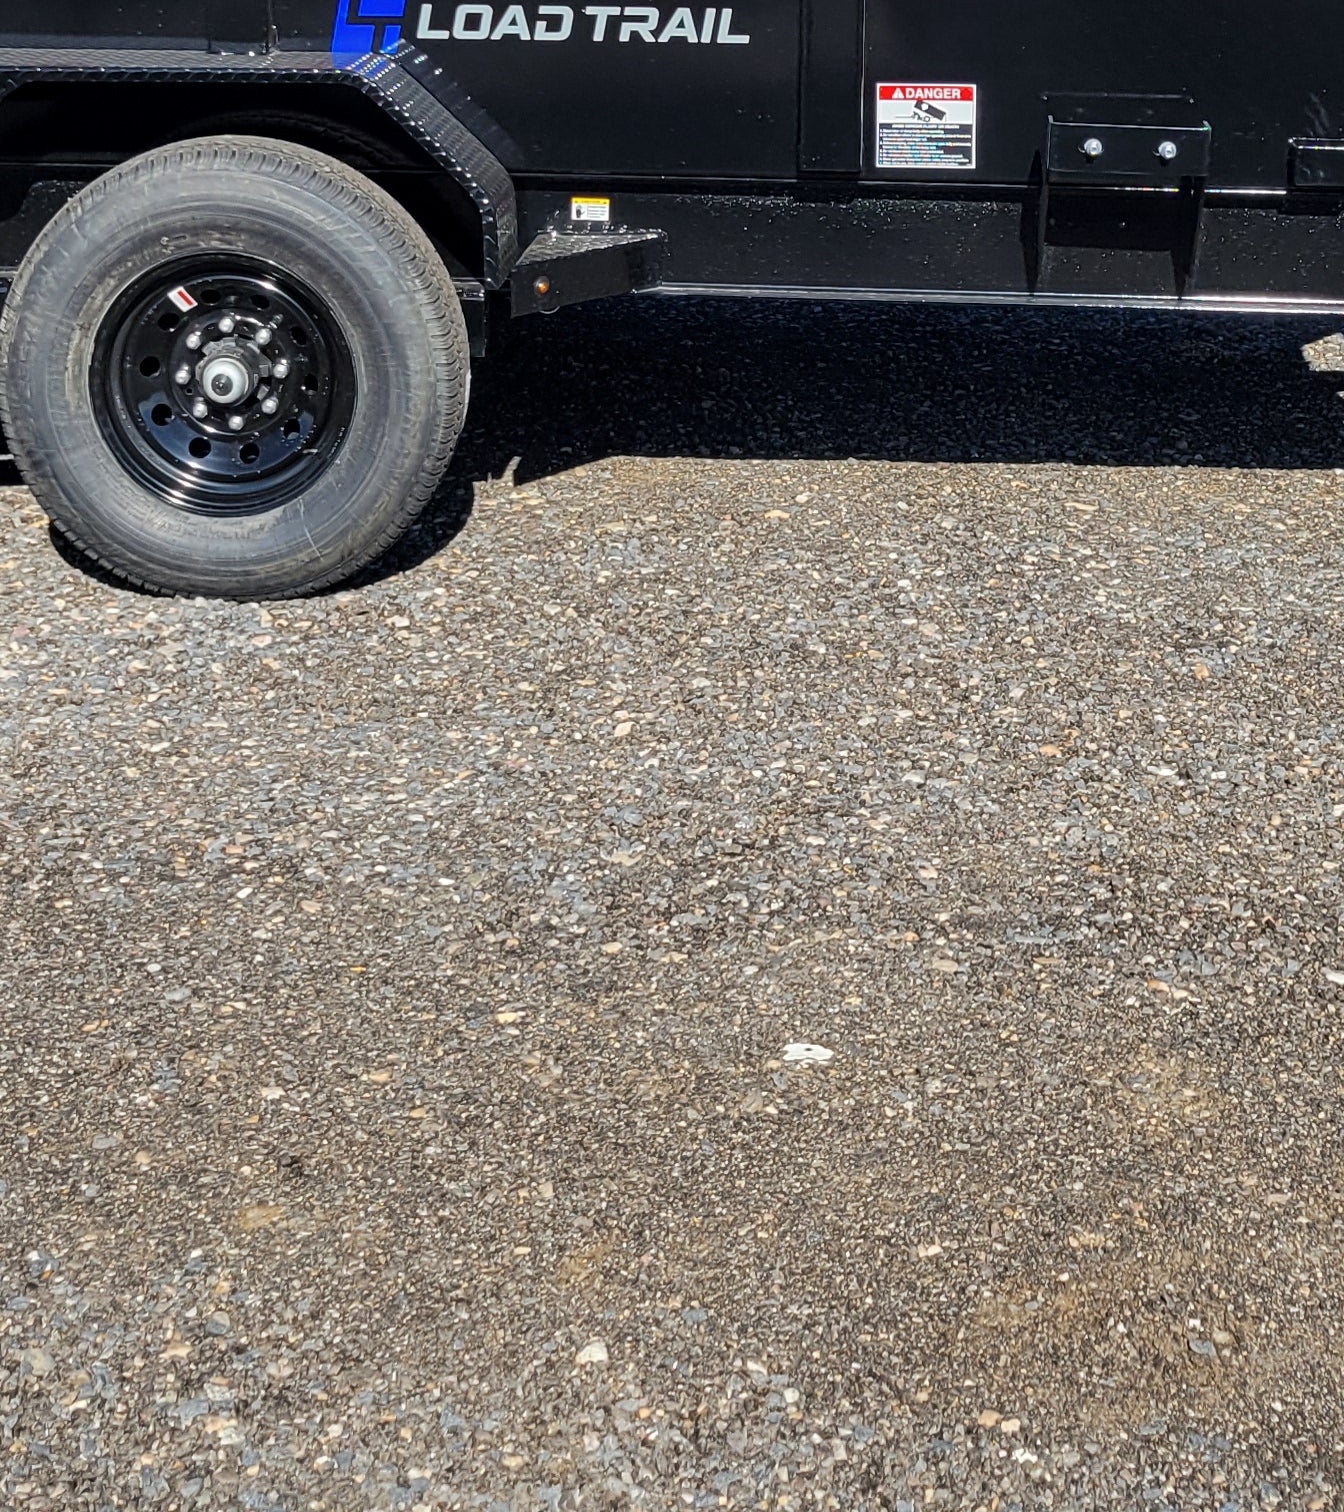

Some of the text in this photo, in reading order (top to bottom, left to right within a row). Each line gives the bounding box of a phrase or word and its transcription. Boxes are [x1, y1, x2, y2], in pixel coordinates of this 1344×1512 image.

[416, 3, 751, 44] LOAD TRAIL
[905, 88, 961, 99] DANGER
